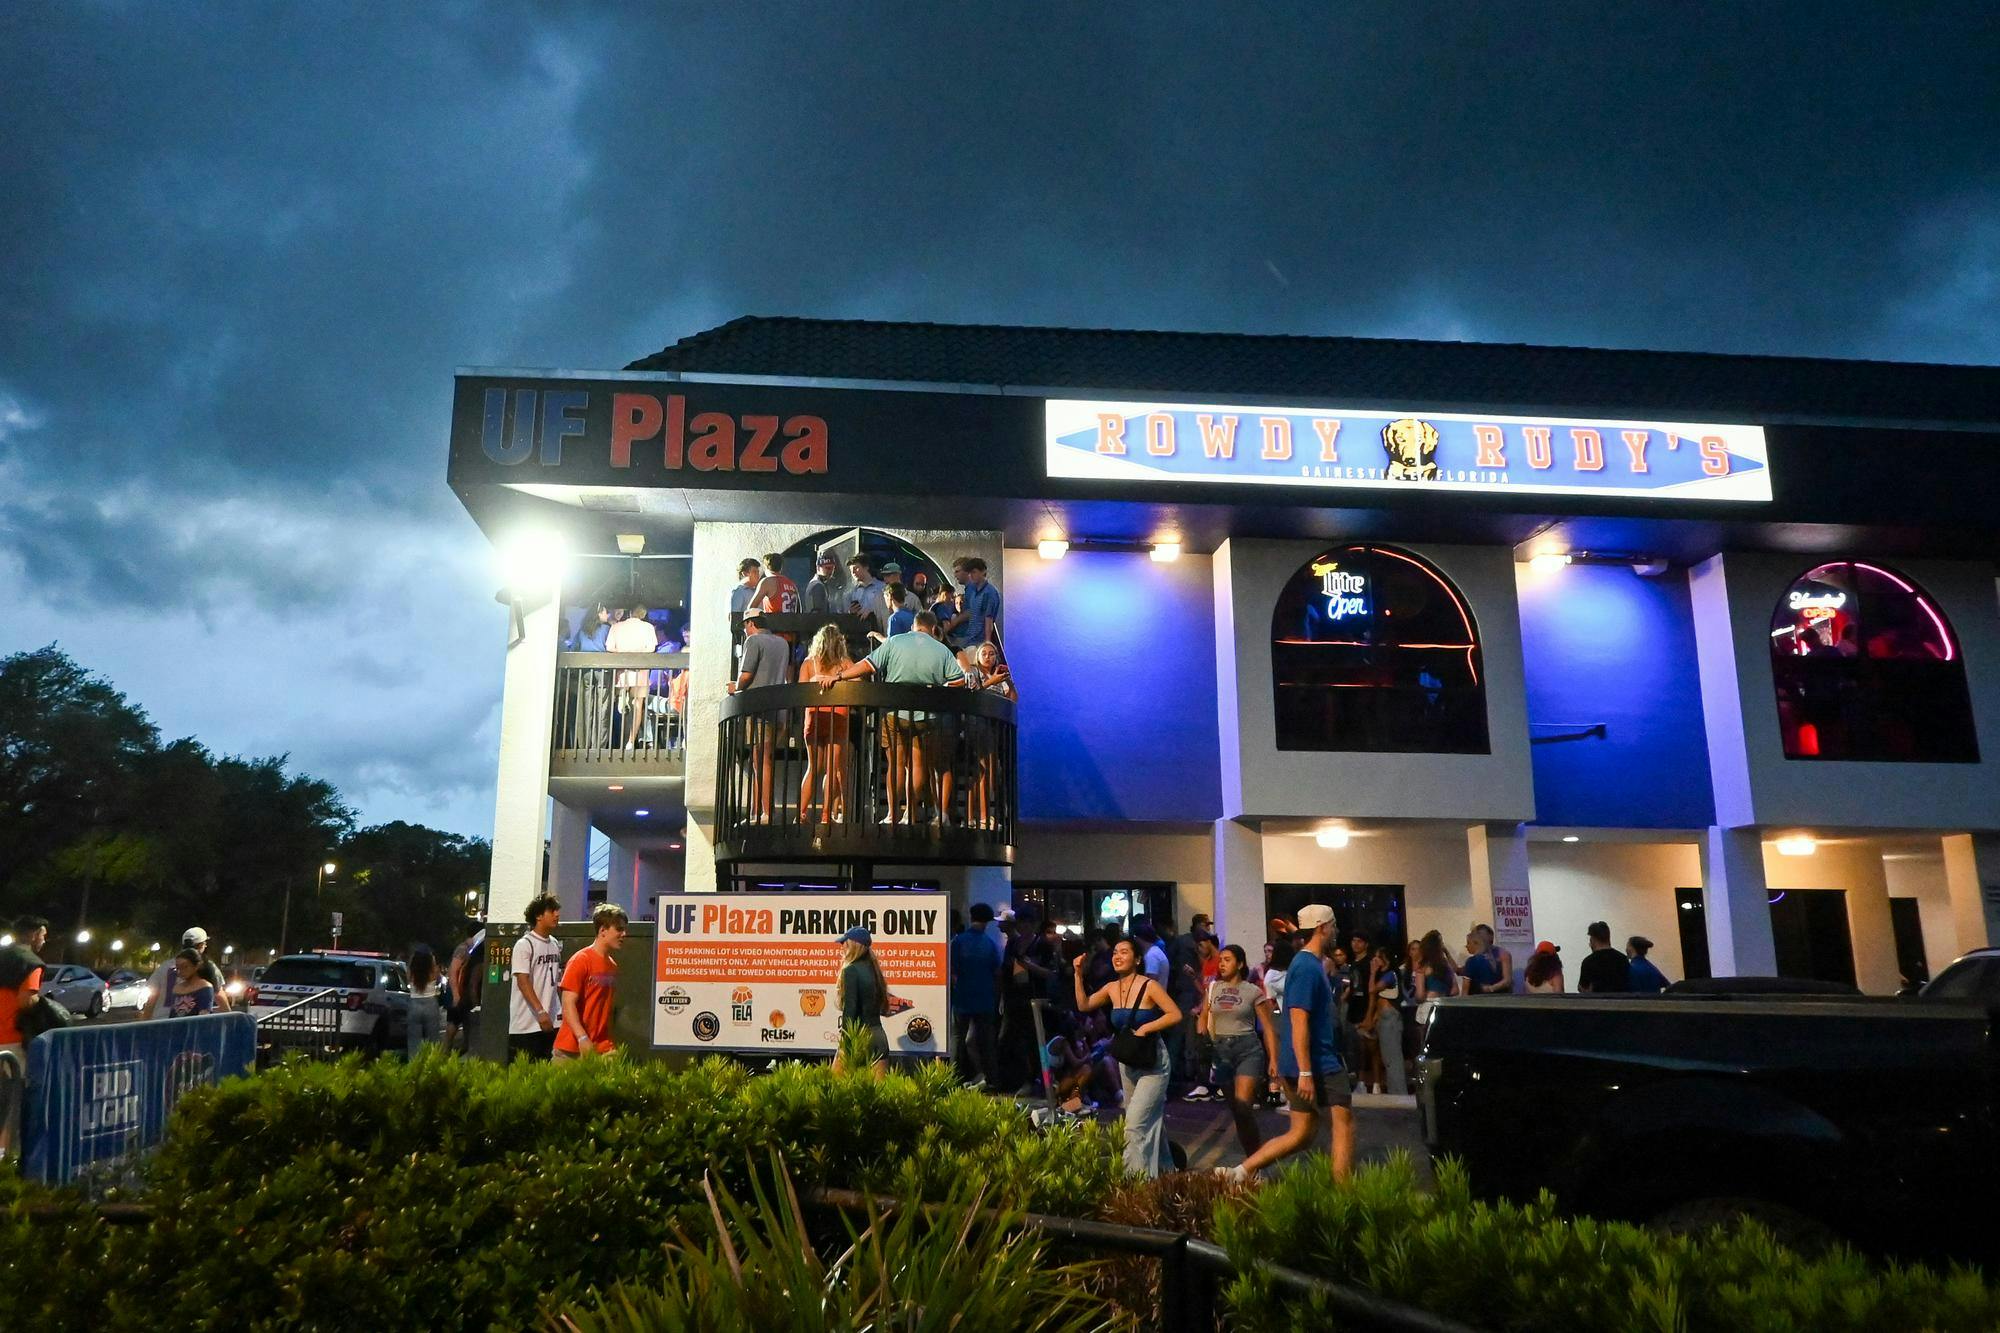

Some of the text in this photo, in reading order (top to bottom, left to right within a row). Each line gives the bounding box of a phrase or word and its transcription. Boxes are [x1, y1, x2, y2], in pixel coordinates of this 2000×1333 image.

[481, 387, 829, 475] UF Plaza
[1096, 412, 1731, 477] ROWDY RUDY'S
[1436, 468, 1509, 484] FLORIDA
[1327, 597, 1368, 620] Open
[1505, 896, 1528, 906] PLAZA
[665, 904, 937, 935] UF Plaza PARKING ONLY
[1496, 906, 1529, 917] PARKING
[1504, 917, 1523, 928] ONLY
[667, 947, 684, 955] THIS
[684, 947, 716, 956] PARKING
[717, 948, 730, 956] LOT
[731, 948, 739, 956] IS
[740, 948, 762, 956] VIDEO
[763, 948, 808, 956] MONITORED
[887, 949, 897, 957] OF
[898, 949, 909, 957] UF
[910, 950, 936, 958] PLAZA
[665, 957, 728, 966] ESTABLISHMENTS
[728, 958, 750, 966] ONLY.
[799, 959, 829, 967] PARKED
[889, 960, 915, 968] OTHER
[916, 960, 937, 968] AREA
[665, 967, 708, 976] BUSINESSES
[708, 968, 727, 976] WILL
[727, 968, 737, 976] BE
[738, 968, 765, 976] TOWED
[777, 969, 808, 977] BOOTED
[808, 969, 819, 977] AT
[819, 969, 834, 977] THE
[902, 970, 939, 978] EXPENSE.
[93, 1069, 132, 1100] BUD
[80, 1095, 139, 1131] LIGHT
